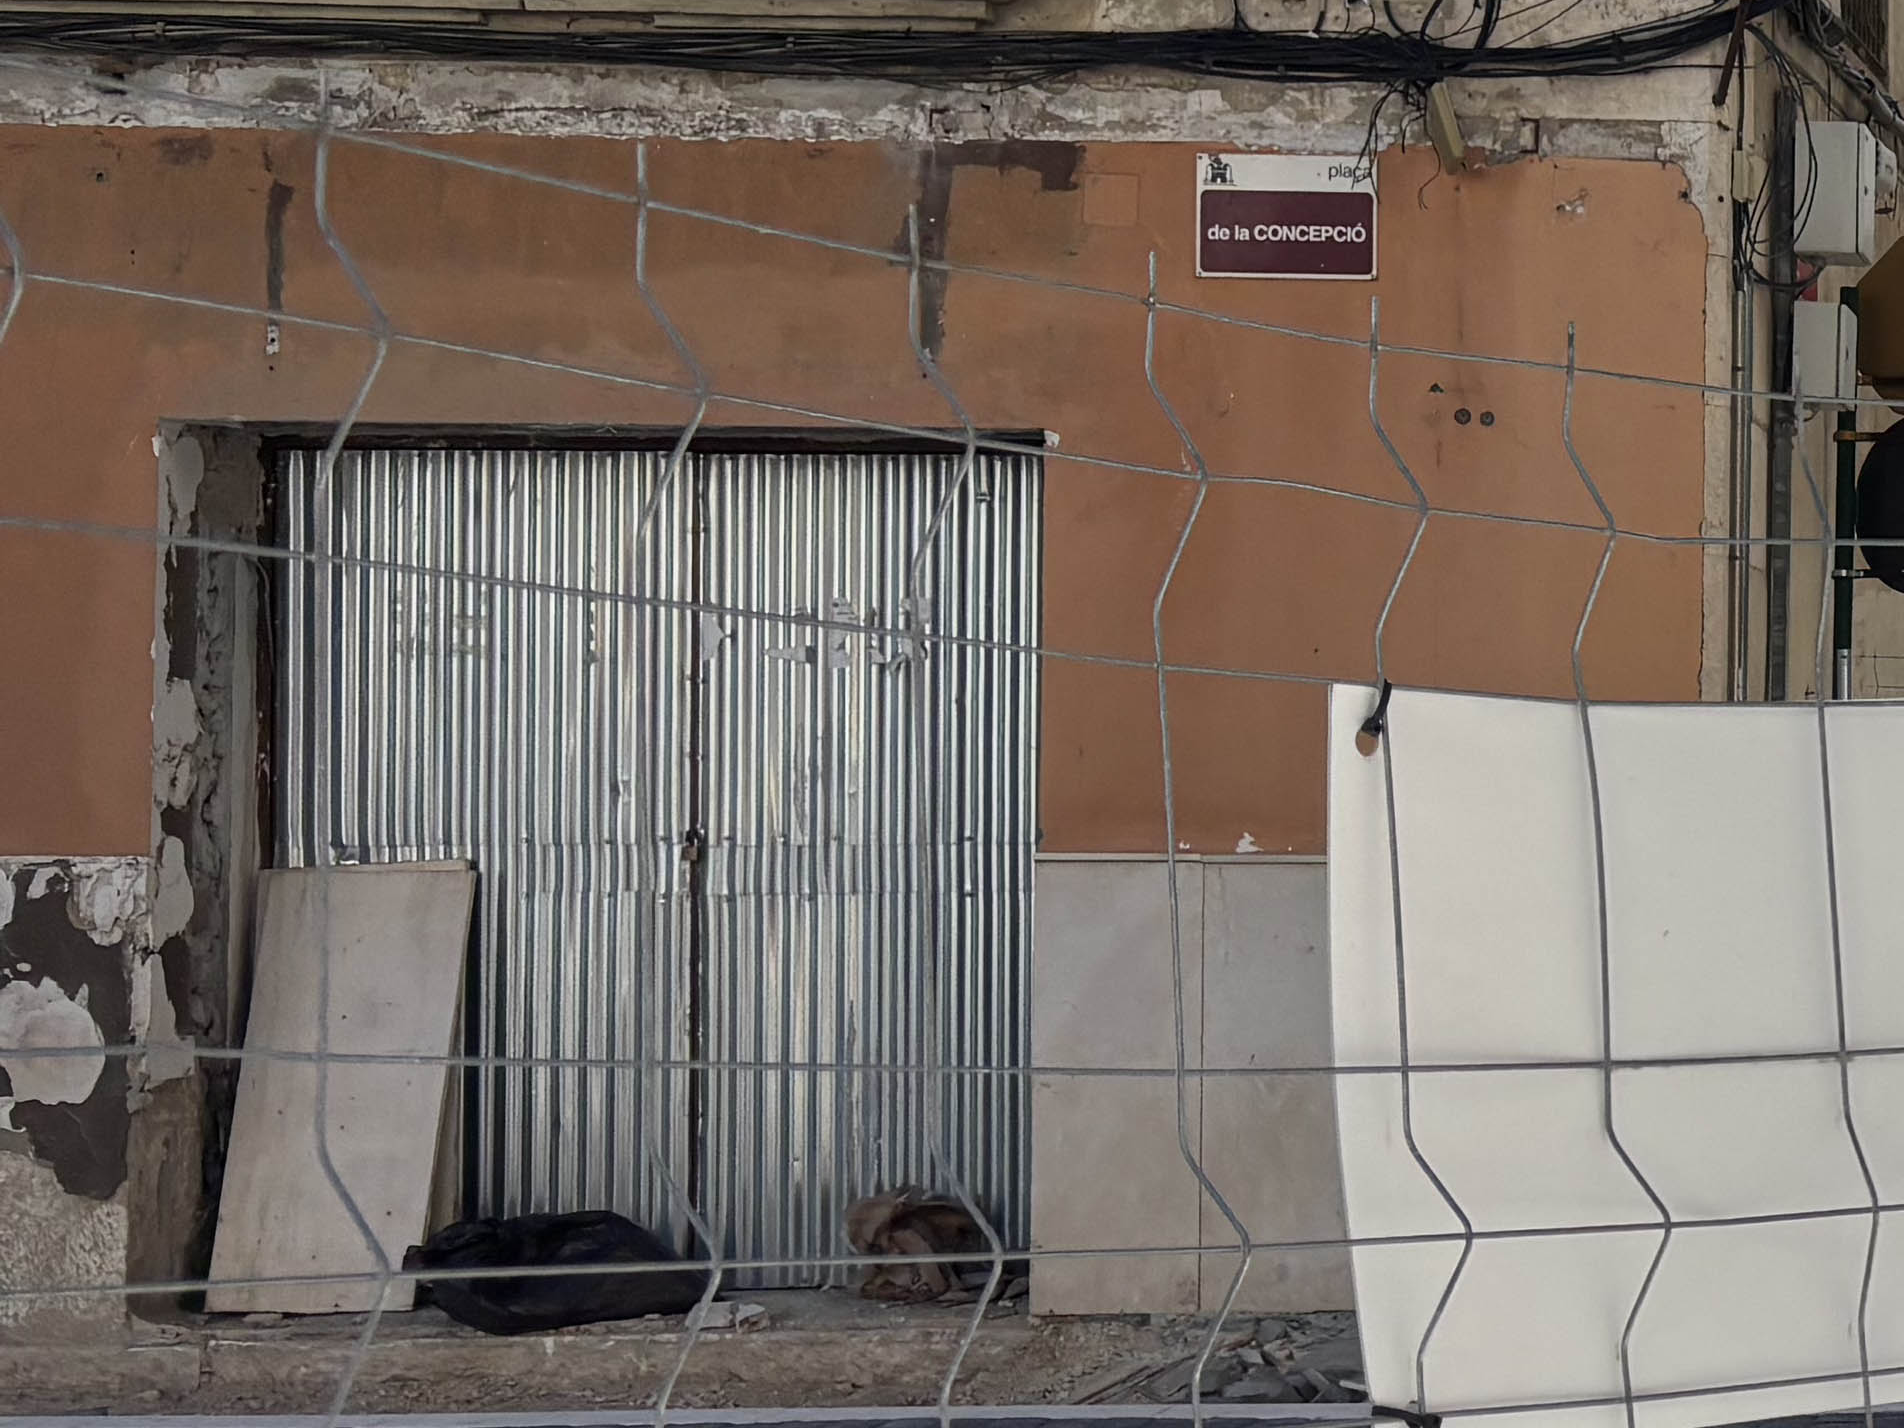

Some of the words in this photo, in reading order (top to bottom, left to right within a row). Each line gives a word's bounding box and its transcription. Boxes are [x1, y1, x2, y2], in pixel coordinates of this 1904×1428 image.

[1328, 163, 1372, 183] plaça
[1207, 224, 1230, 241] de
[1235, 225, 1250, 241] la
[1253, 222, 1367, 243] CONCEPCIÓ
